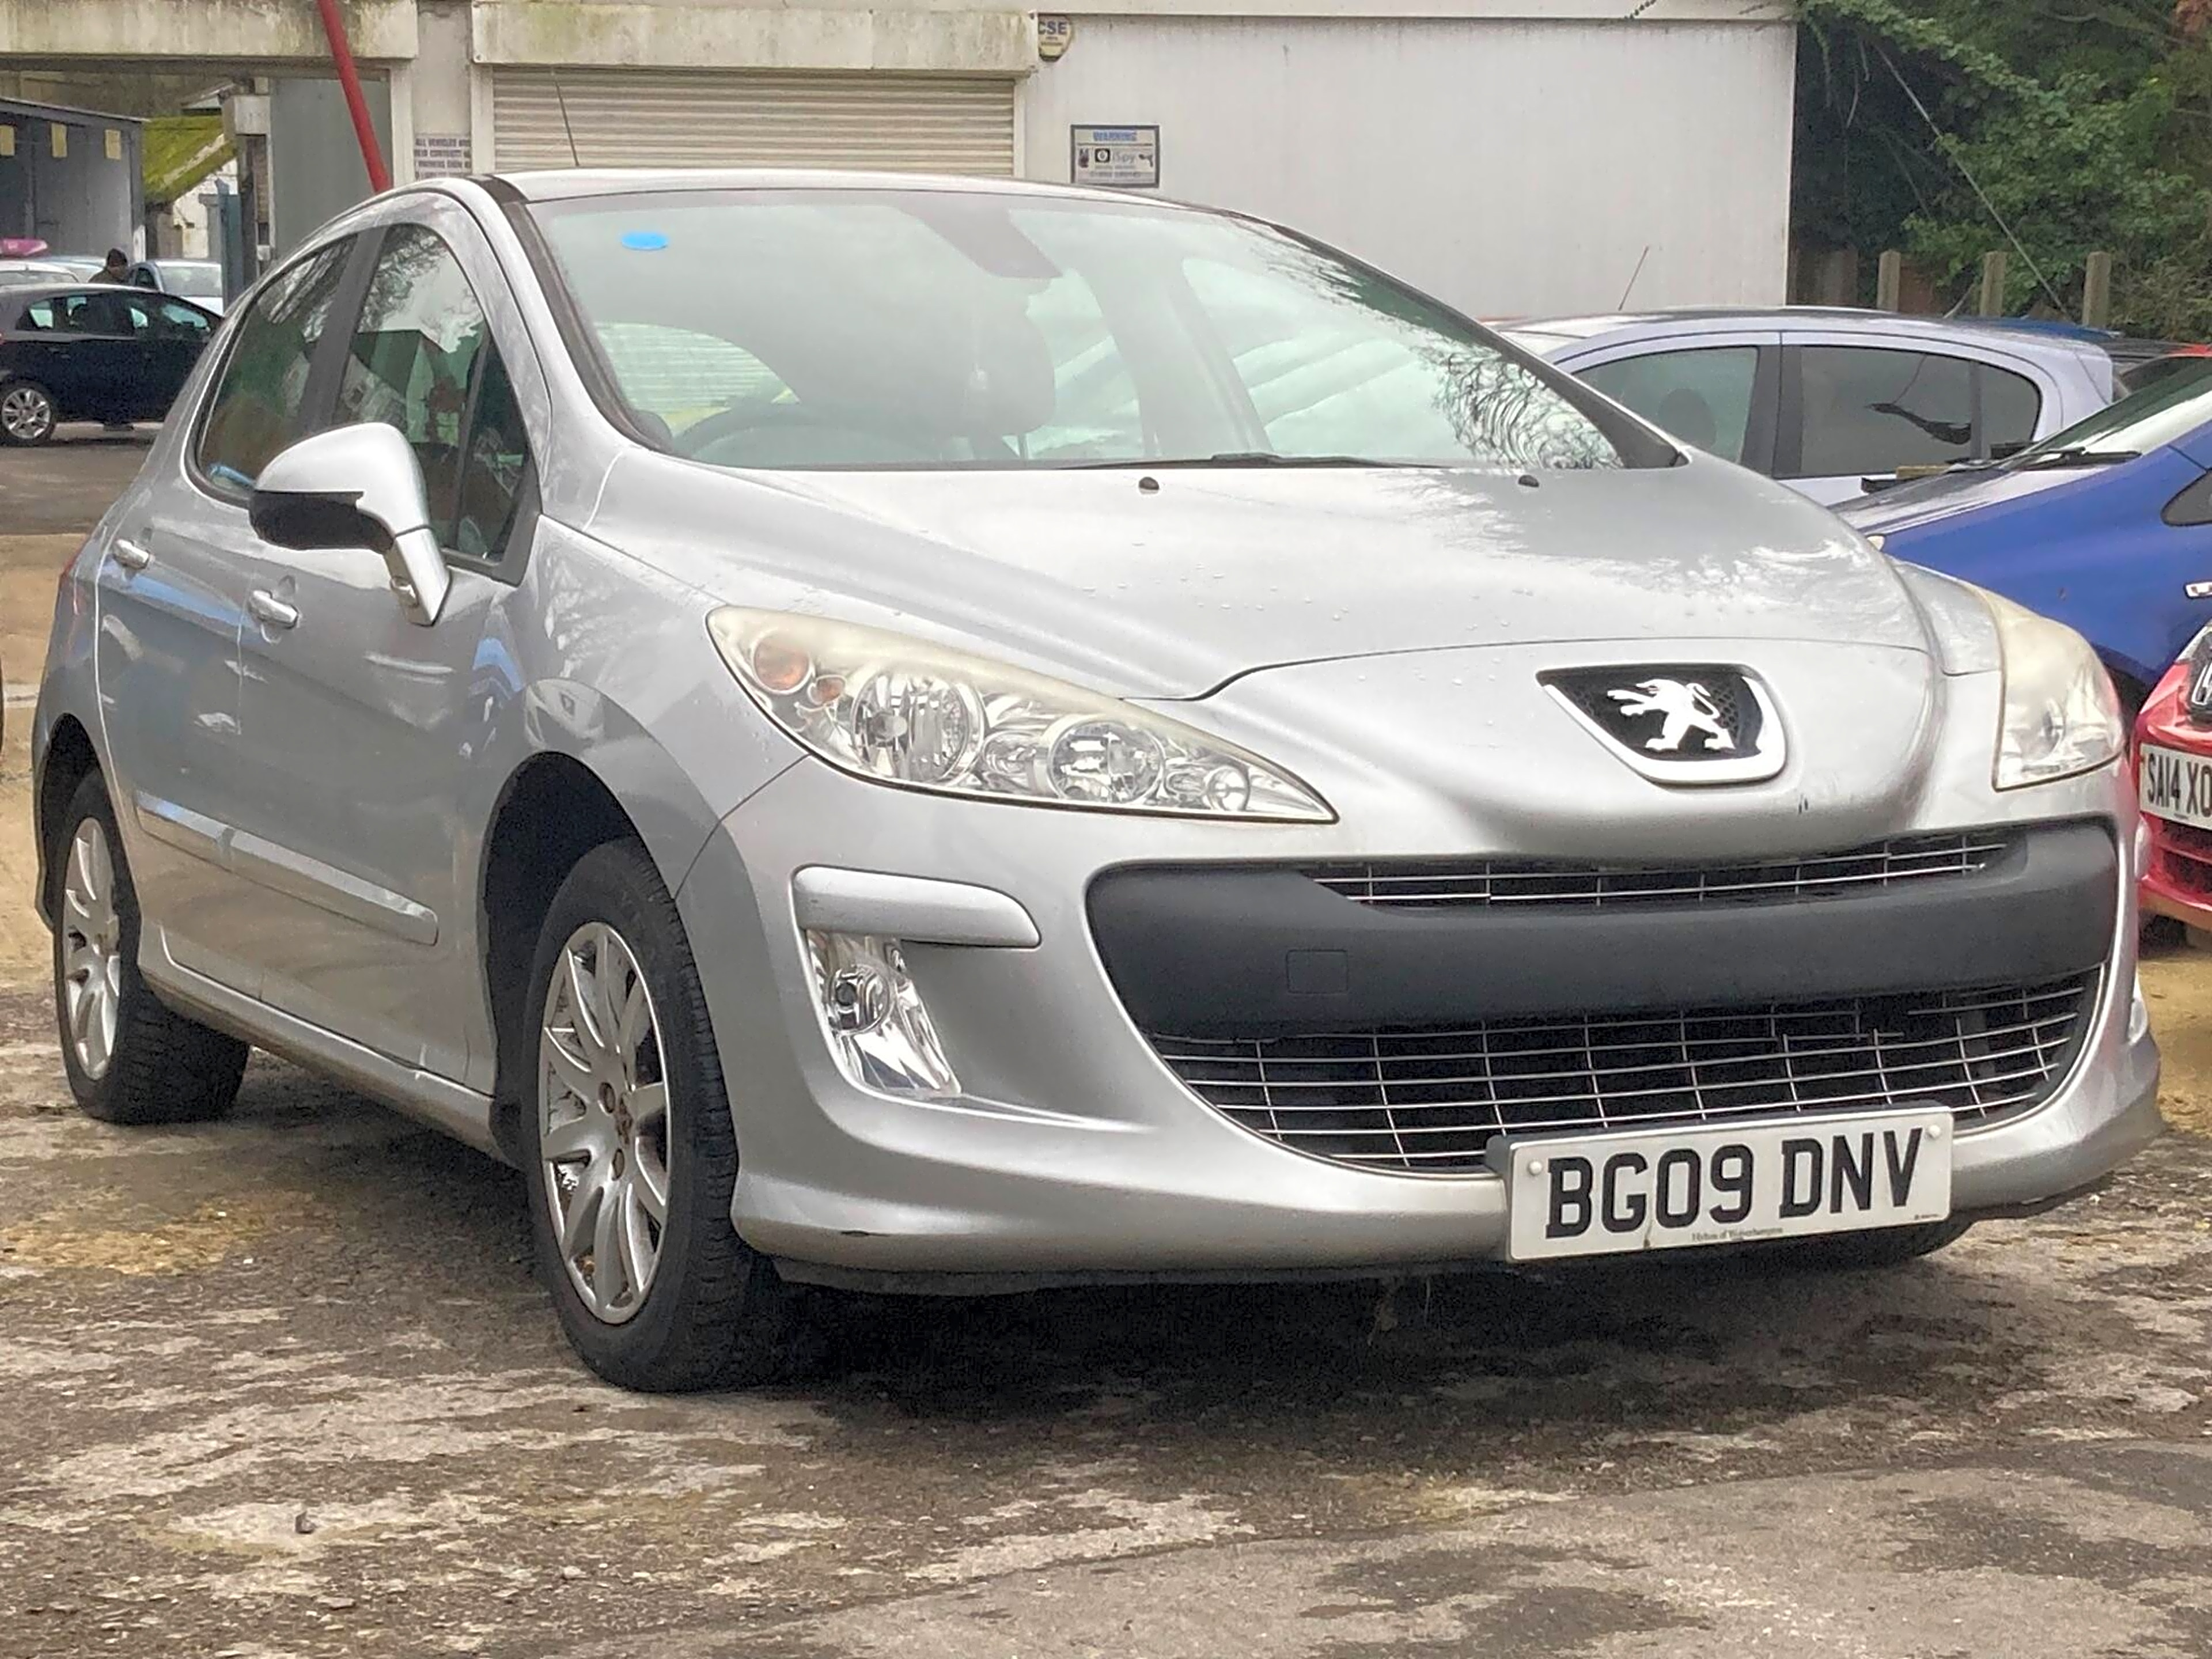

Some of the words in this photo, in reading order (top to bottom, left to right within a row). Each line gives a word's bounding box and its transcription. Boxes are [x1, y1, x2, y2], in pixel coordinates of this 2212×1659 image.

[1038, 21, 1067, 35] CSE
[2147, 753, 2181, 810] SA14
[2187, 762, 2212, 817] XO
[1546, 1143, 1754, 1239] BG09
[1779, 1127, 1923, 1219] DNV
